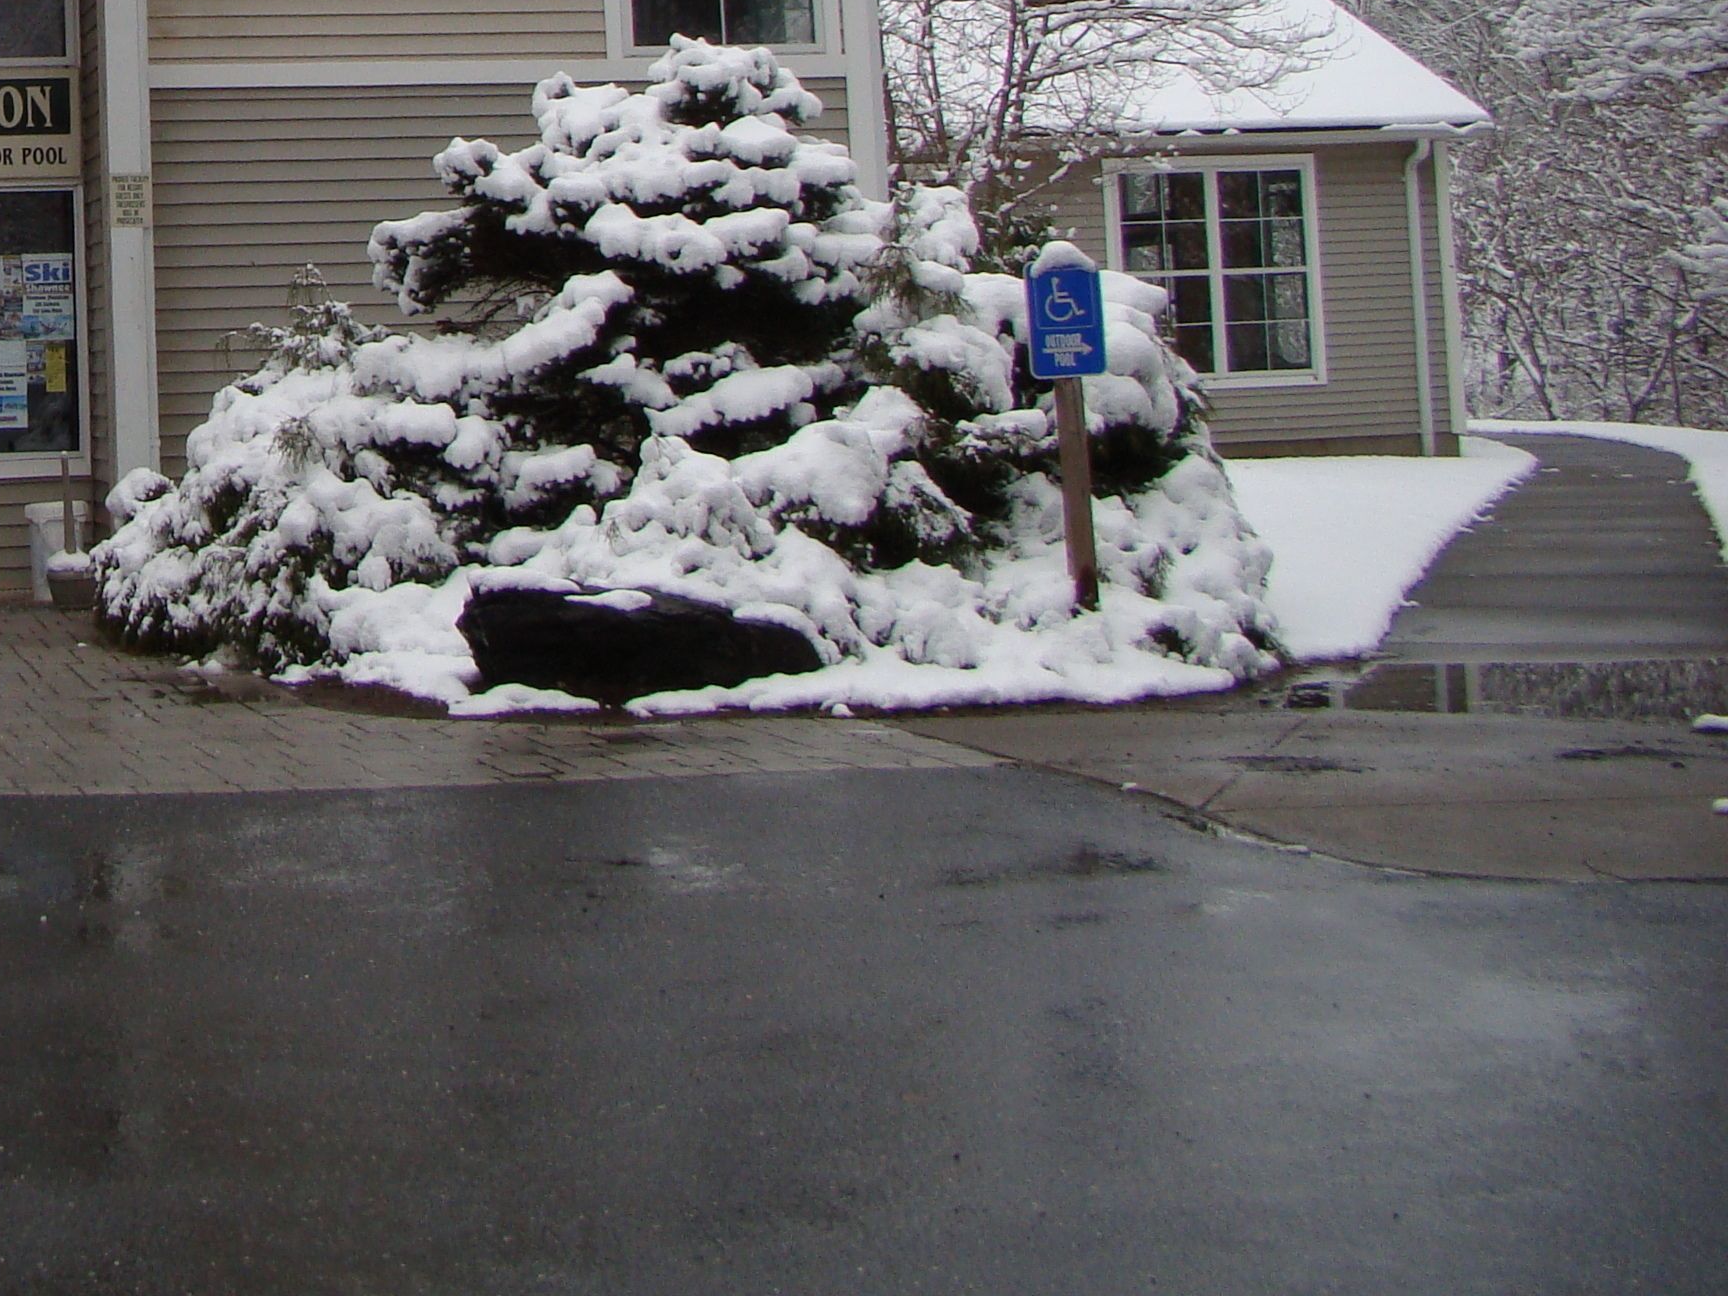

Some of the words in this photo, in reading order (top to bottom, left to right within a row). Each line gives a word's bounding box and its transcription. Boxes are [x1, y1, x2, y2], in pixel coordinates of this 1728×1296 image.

[22, 146, 67, 165] POOL
[25, 263, 69, 281] Ski
[1045, 334, 1081, 348] OUTDOOR
[1054, 353, 1076, 366] POOL
